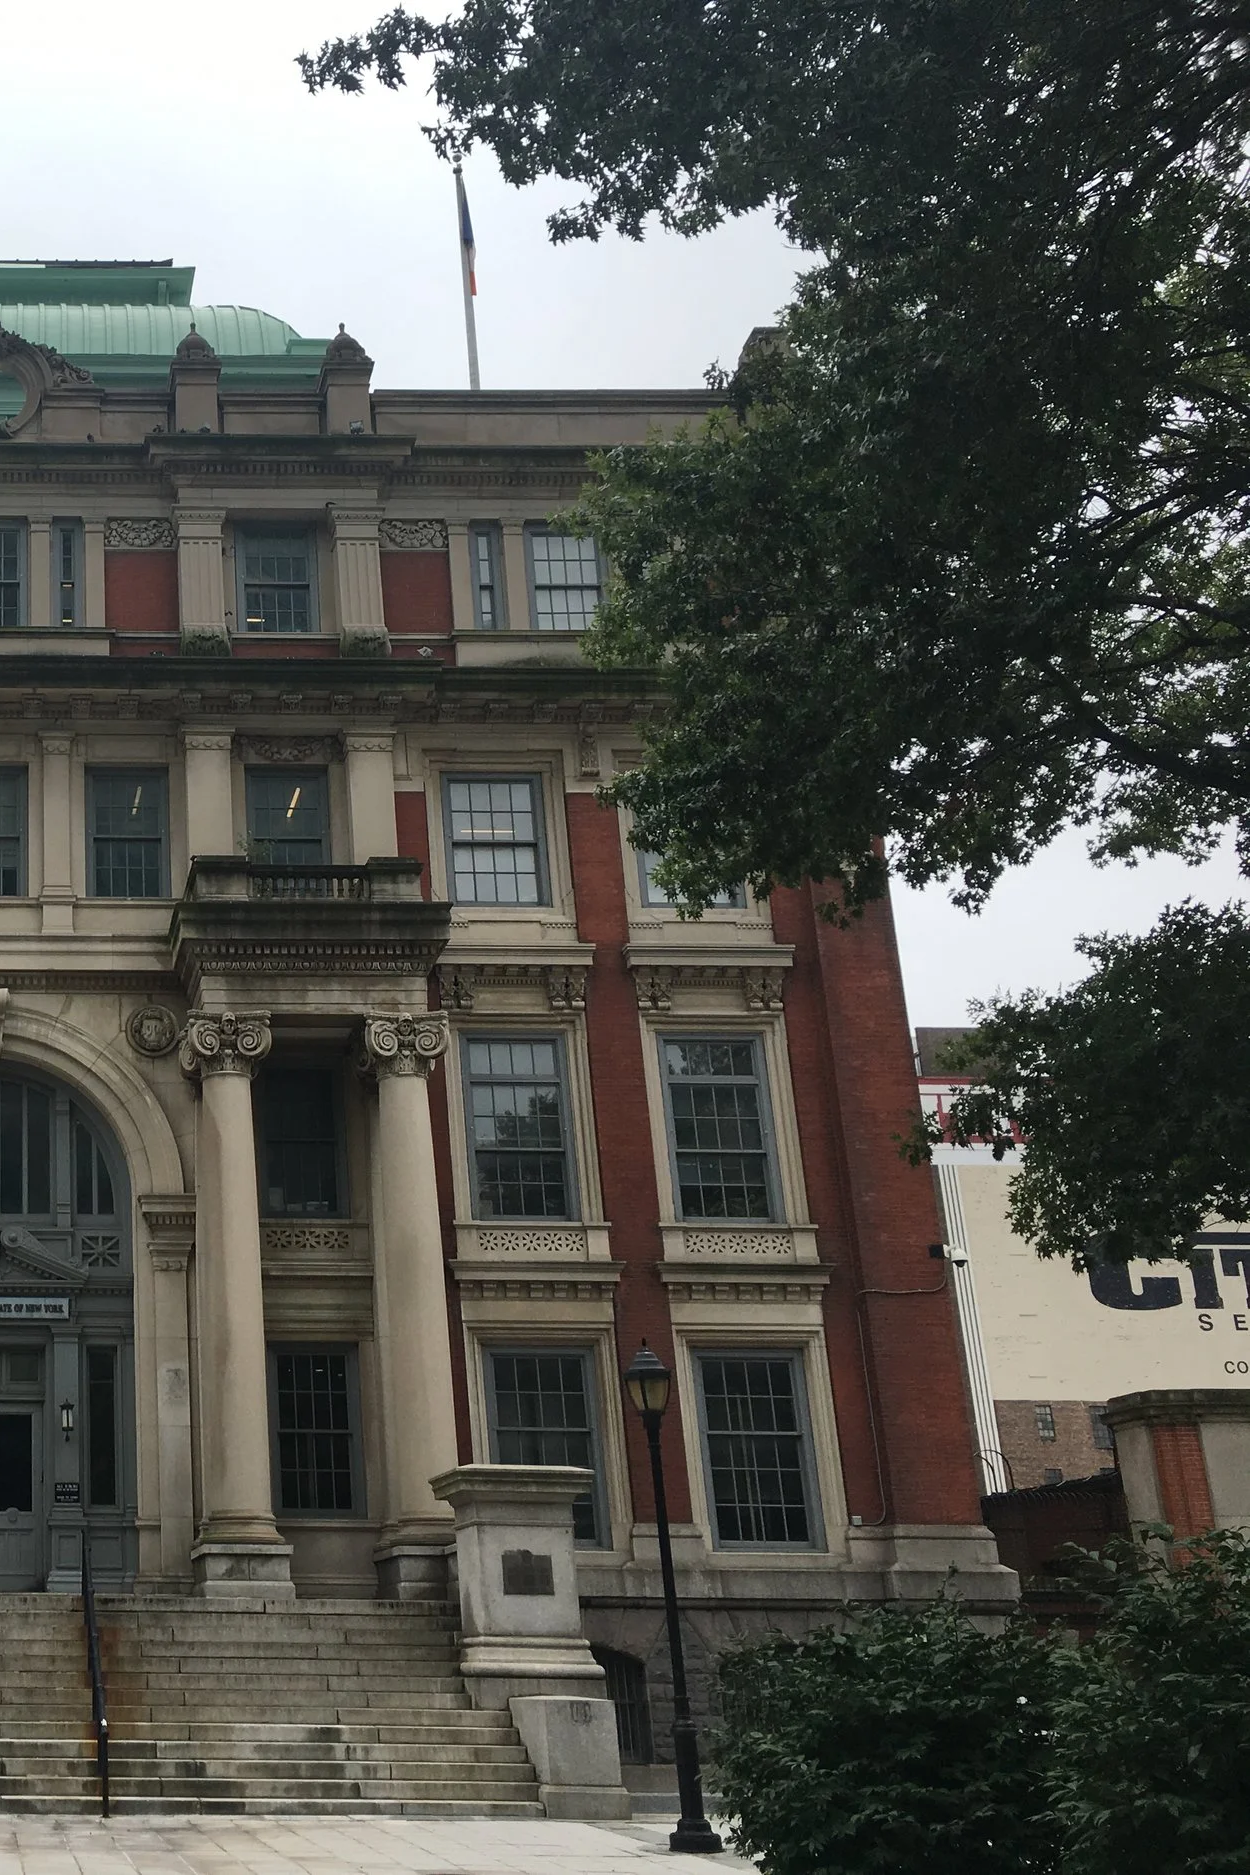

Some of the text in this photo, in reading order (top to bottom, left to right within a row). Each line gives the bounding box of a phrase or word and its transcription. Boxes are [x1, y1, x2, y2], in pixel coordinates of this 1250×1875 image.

[13, 1304, 24, 1313] OF
[25, 1304, 42, 1313] NEW
[43, 1304, 65, 1313] YORK
